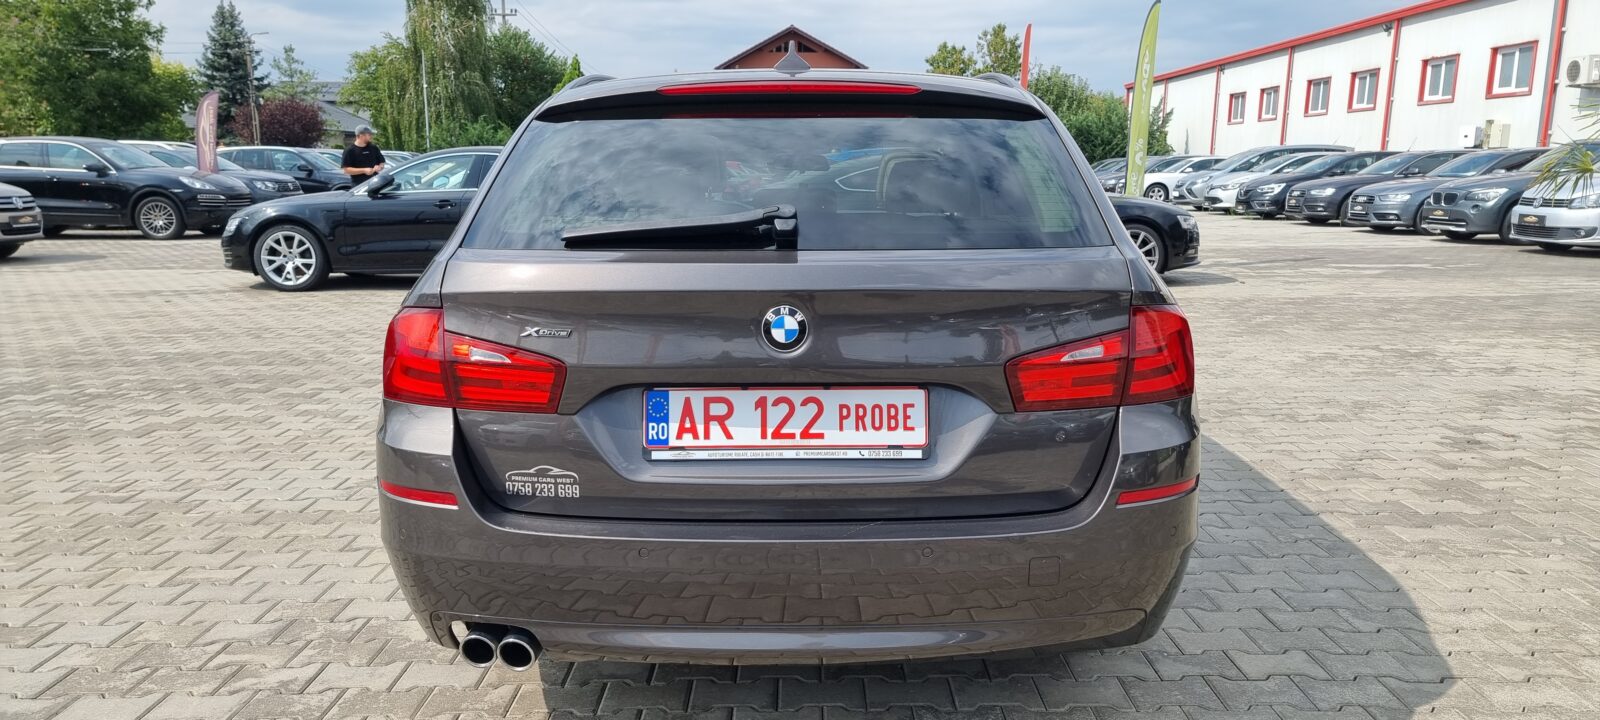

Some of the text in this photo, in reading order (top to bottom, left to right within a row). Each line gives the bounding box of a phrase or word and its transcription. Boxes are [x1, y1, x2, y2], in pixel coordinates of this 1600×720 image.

[766, 307, 804, 322] BMW
[675, 395, 916, 441] AR 122 PROBE
[648, 422, 668, 440] RO
[505, 482, 580, 498] 0758 233 699
